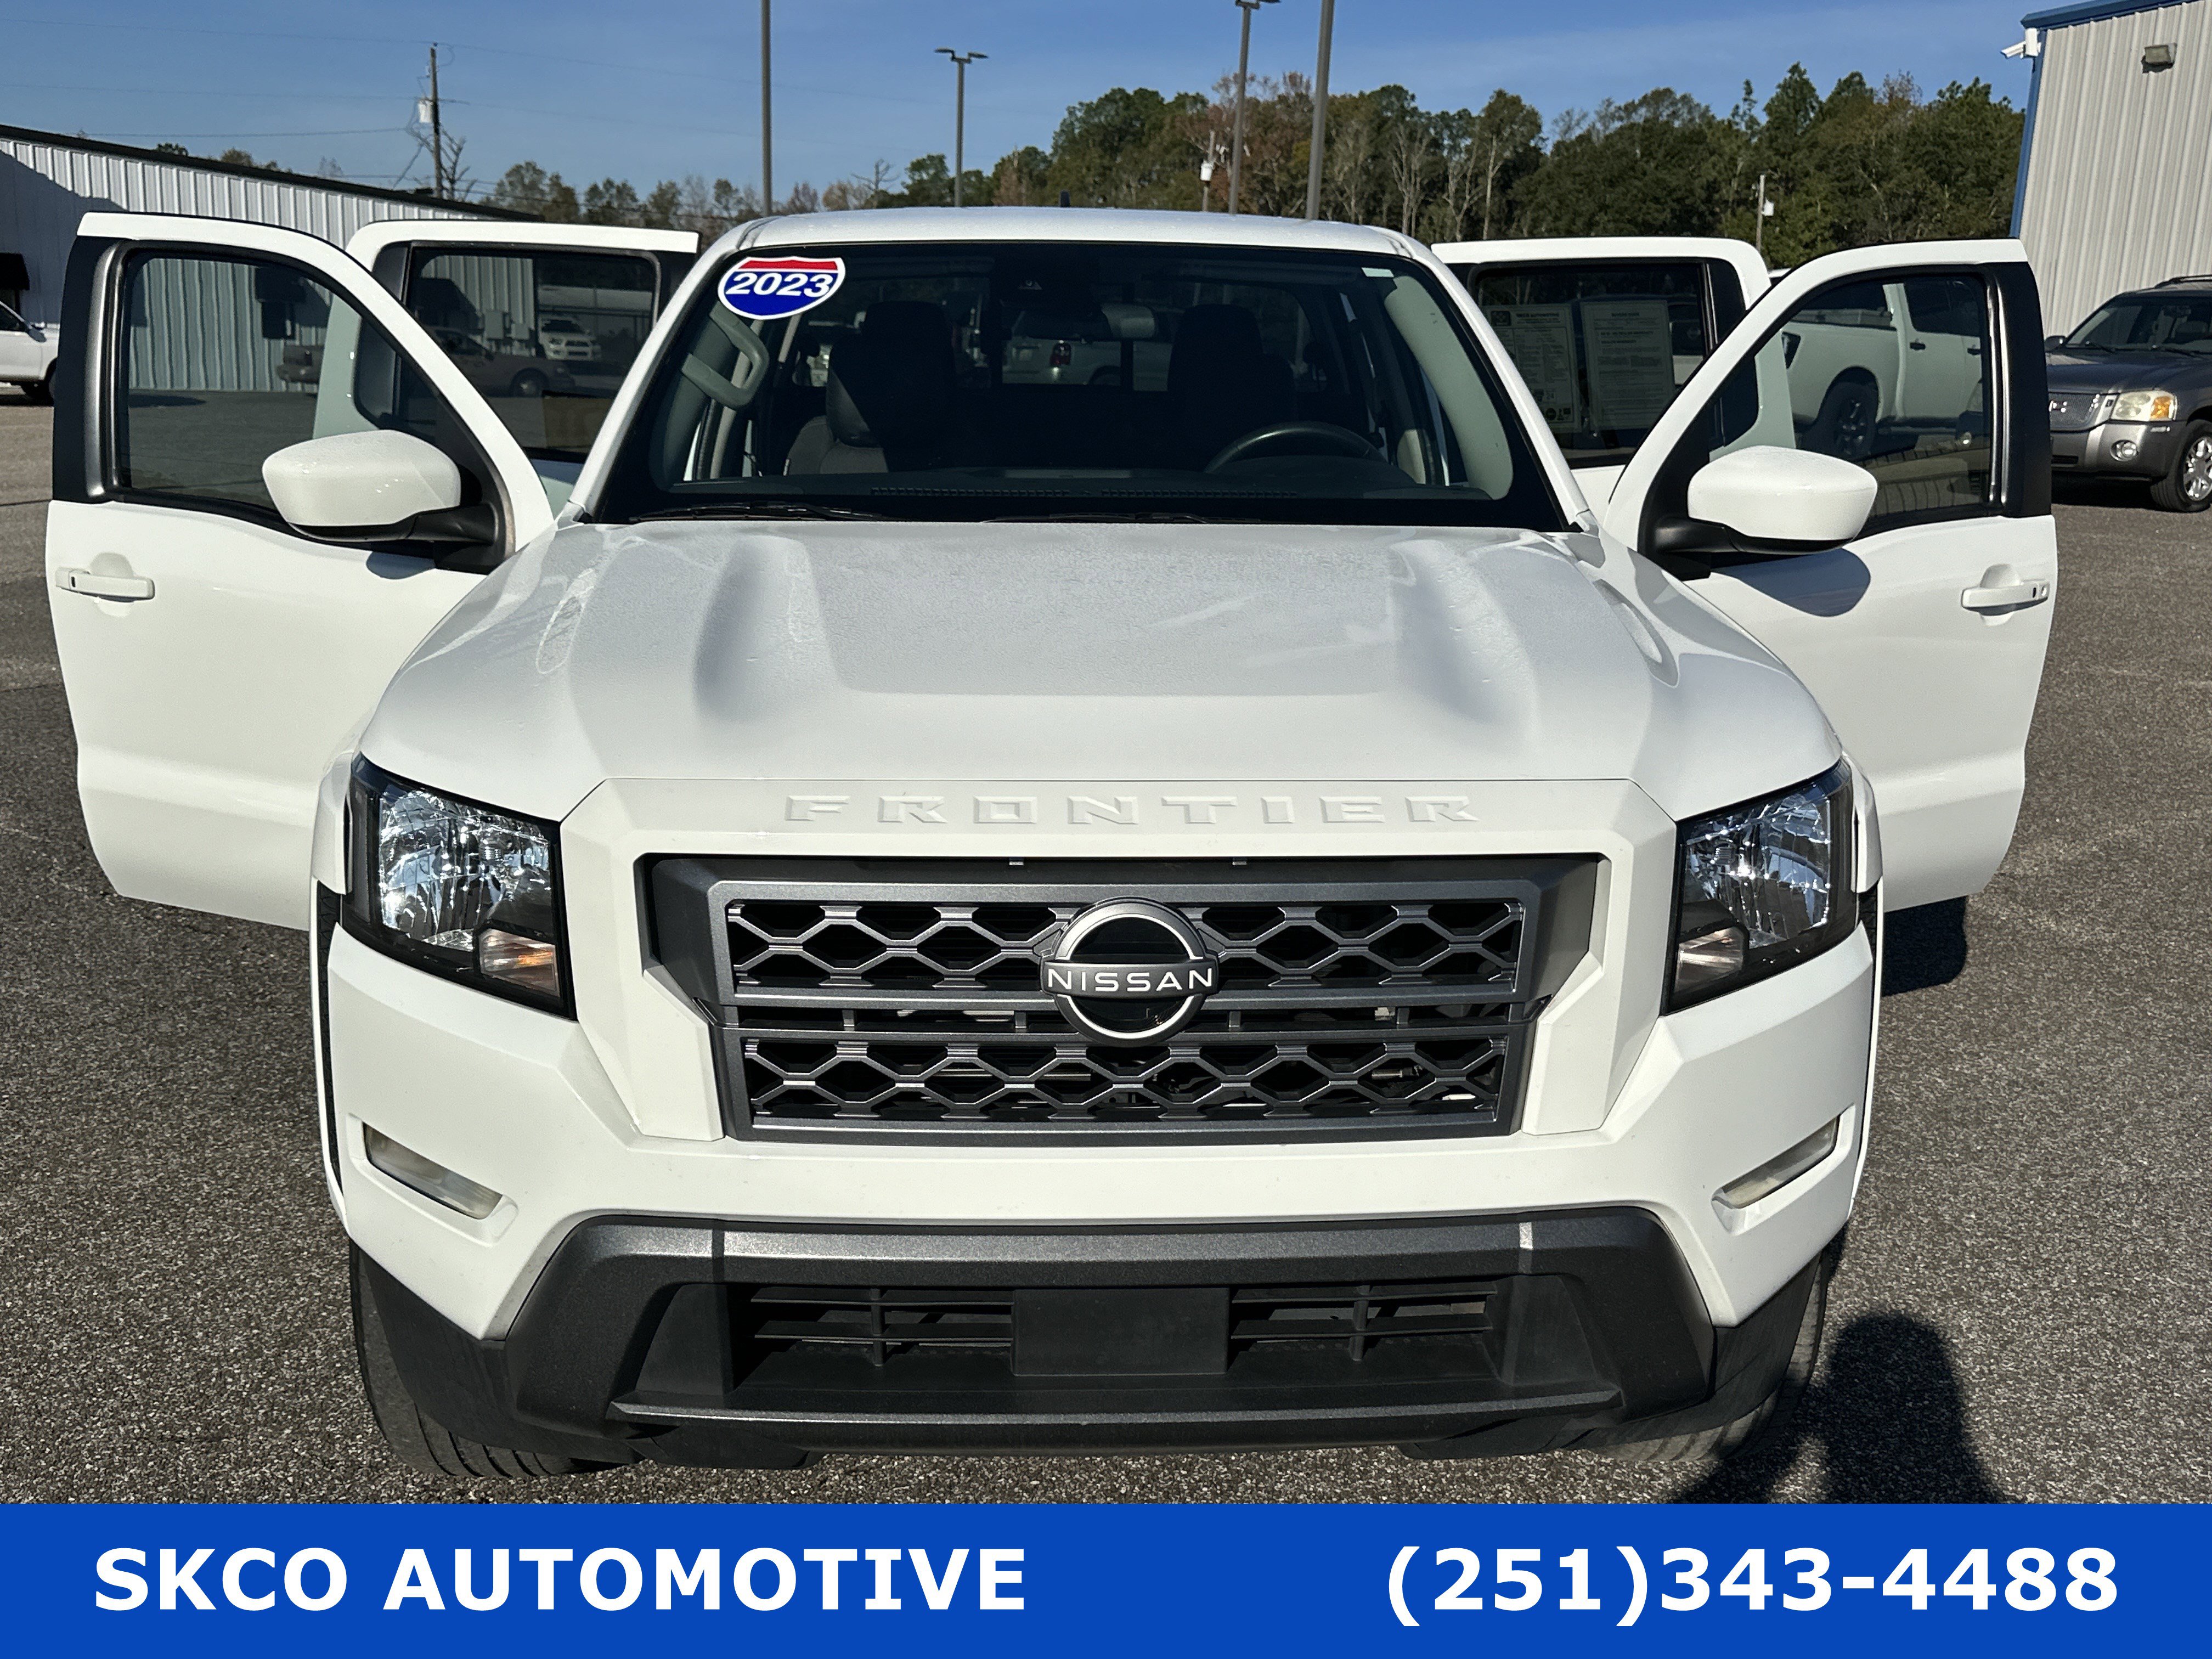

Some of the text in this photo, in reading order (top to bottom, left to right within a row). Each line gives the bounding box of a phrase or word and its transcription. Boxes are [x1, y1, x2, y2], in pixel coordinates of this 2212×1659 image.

[725, 273, 833, 297] 2023
[785, 795, 1481, 825] FRONTIER
[1048, 967, 1212, 991] NISSAN
